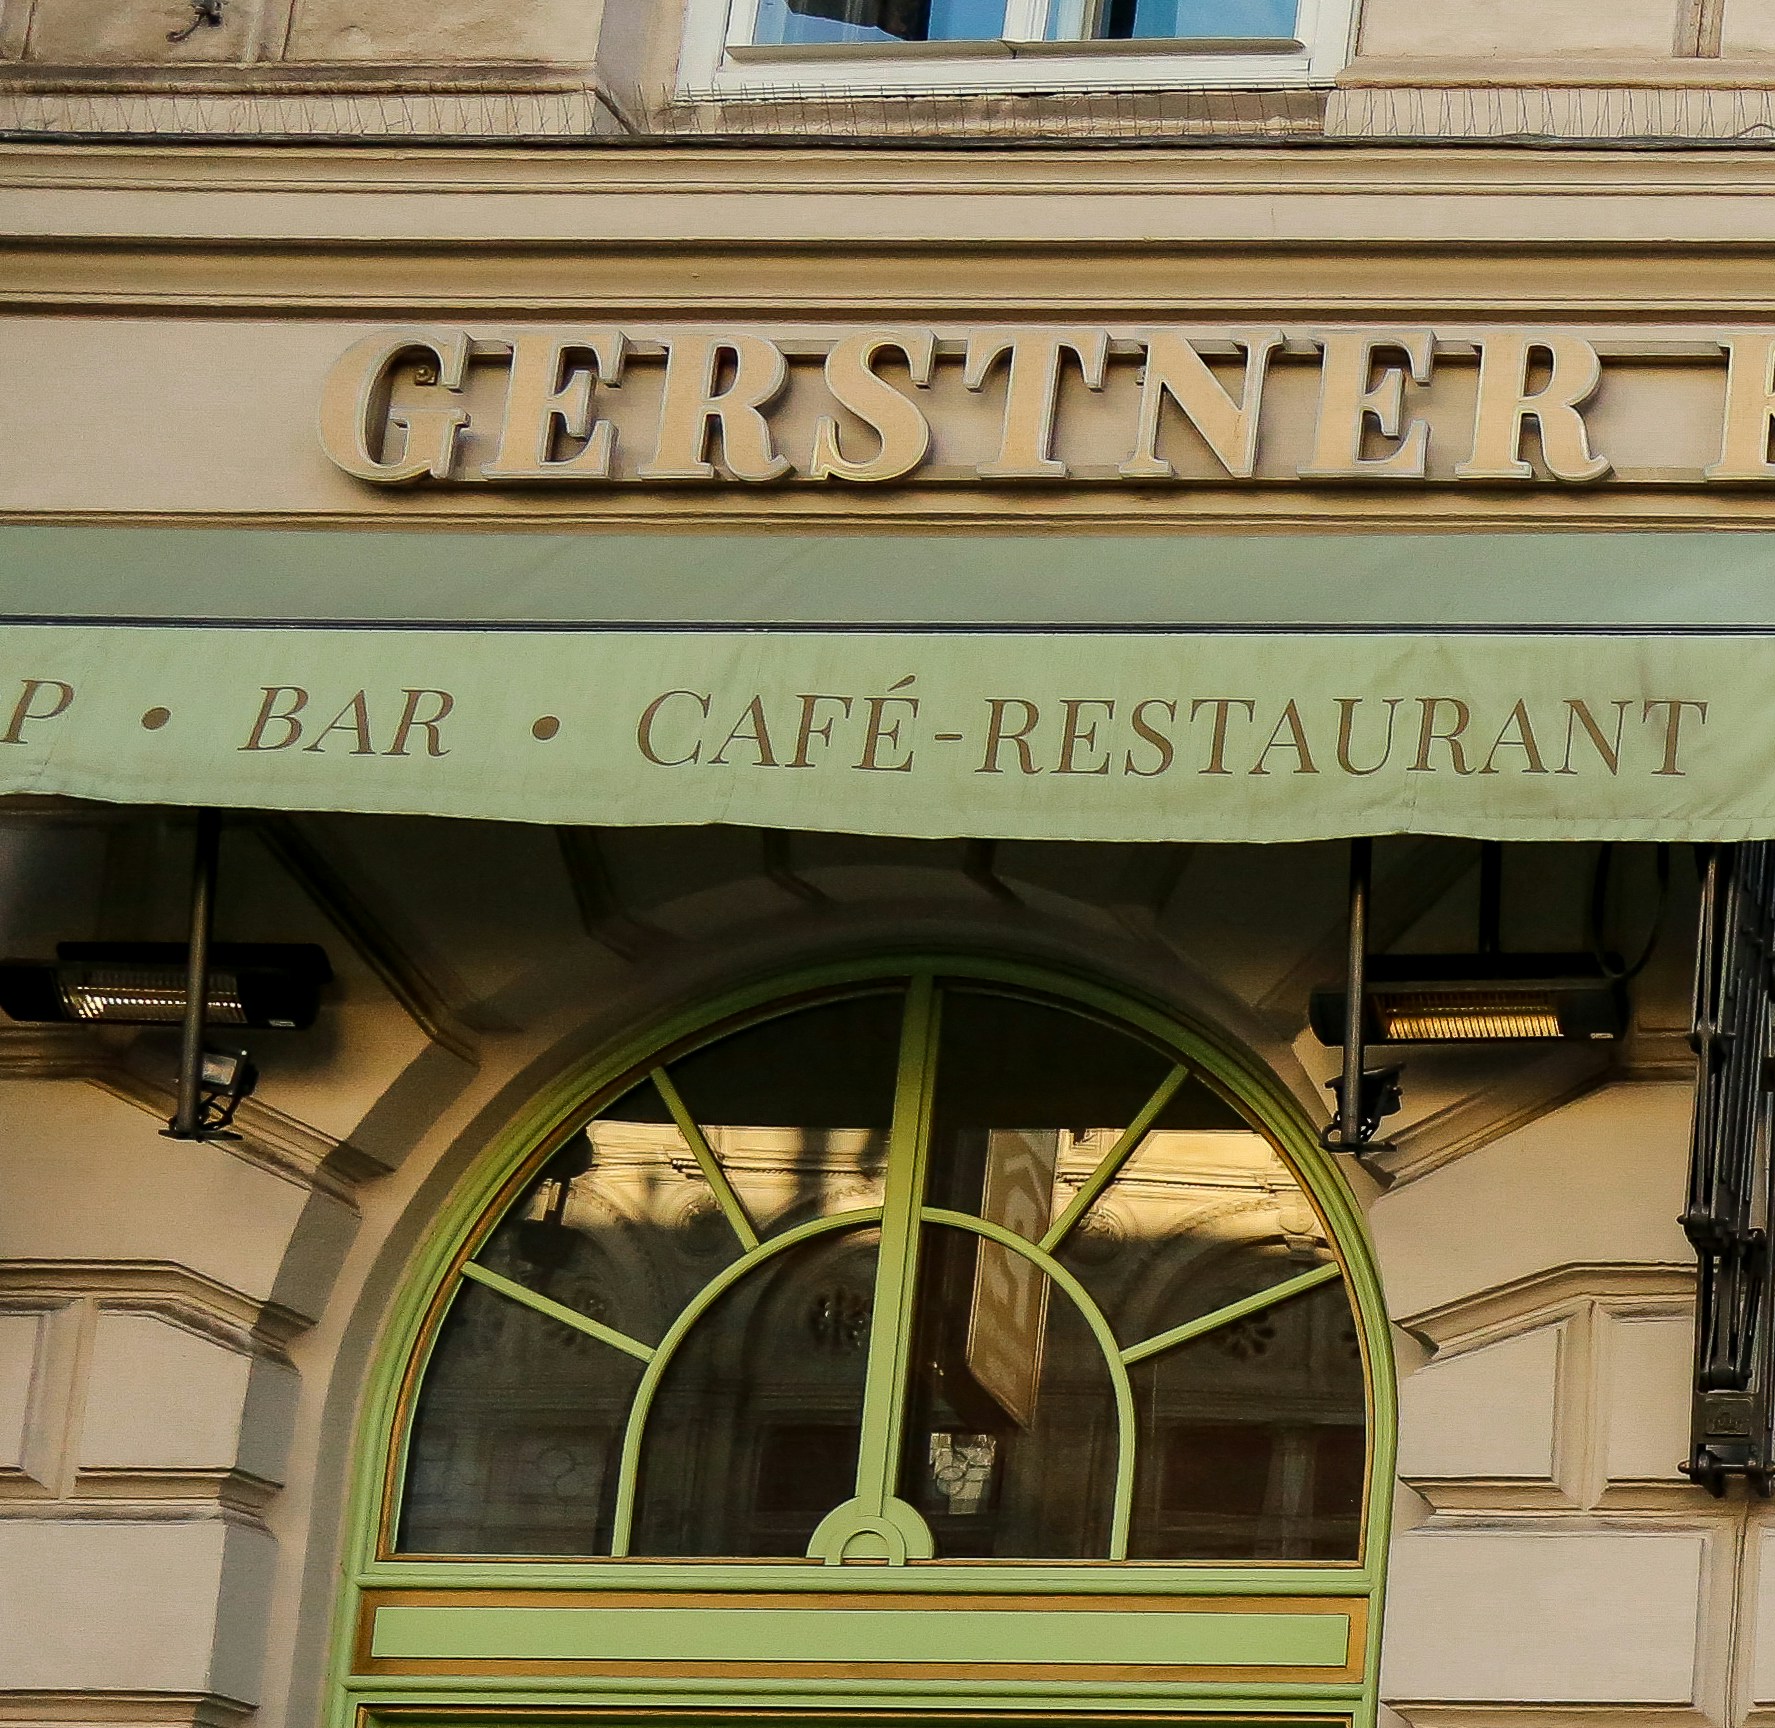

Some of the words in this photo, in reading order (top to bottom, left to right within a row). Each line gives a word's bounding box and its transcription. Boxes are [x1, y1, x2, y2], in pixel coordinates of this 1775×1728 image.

[319, 328, 1613, 485] GERSTNER
[237, 686, 455, 757] BAR
[636, 674, 1709, 778] CAFÉ-RESTAURANT
